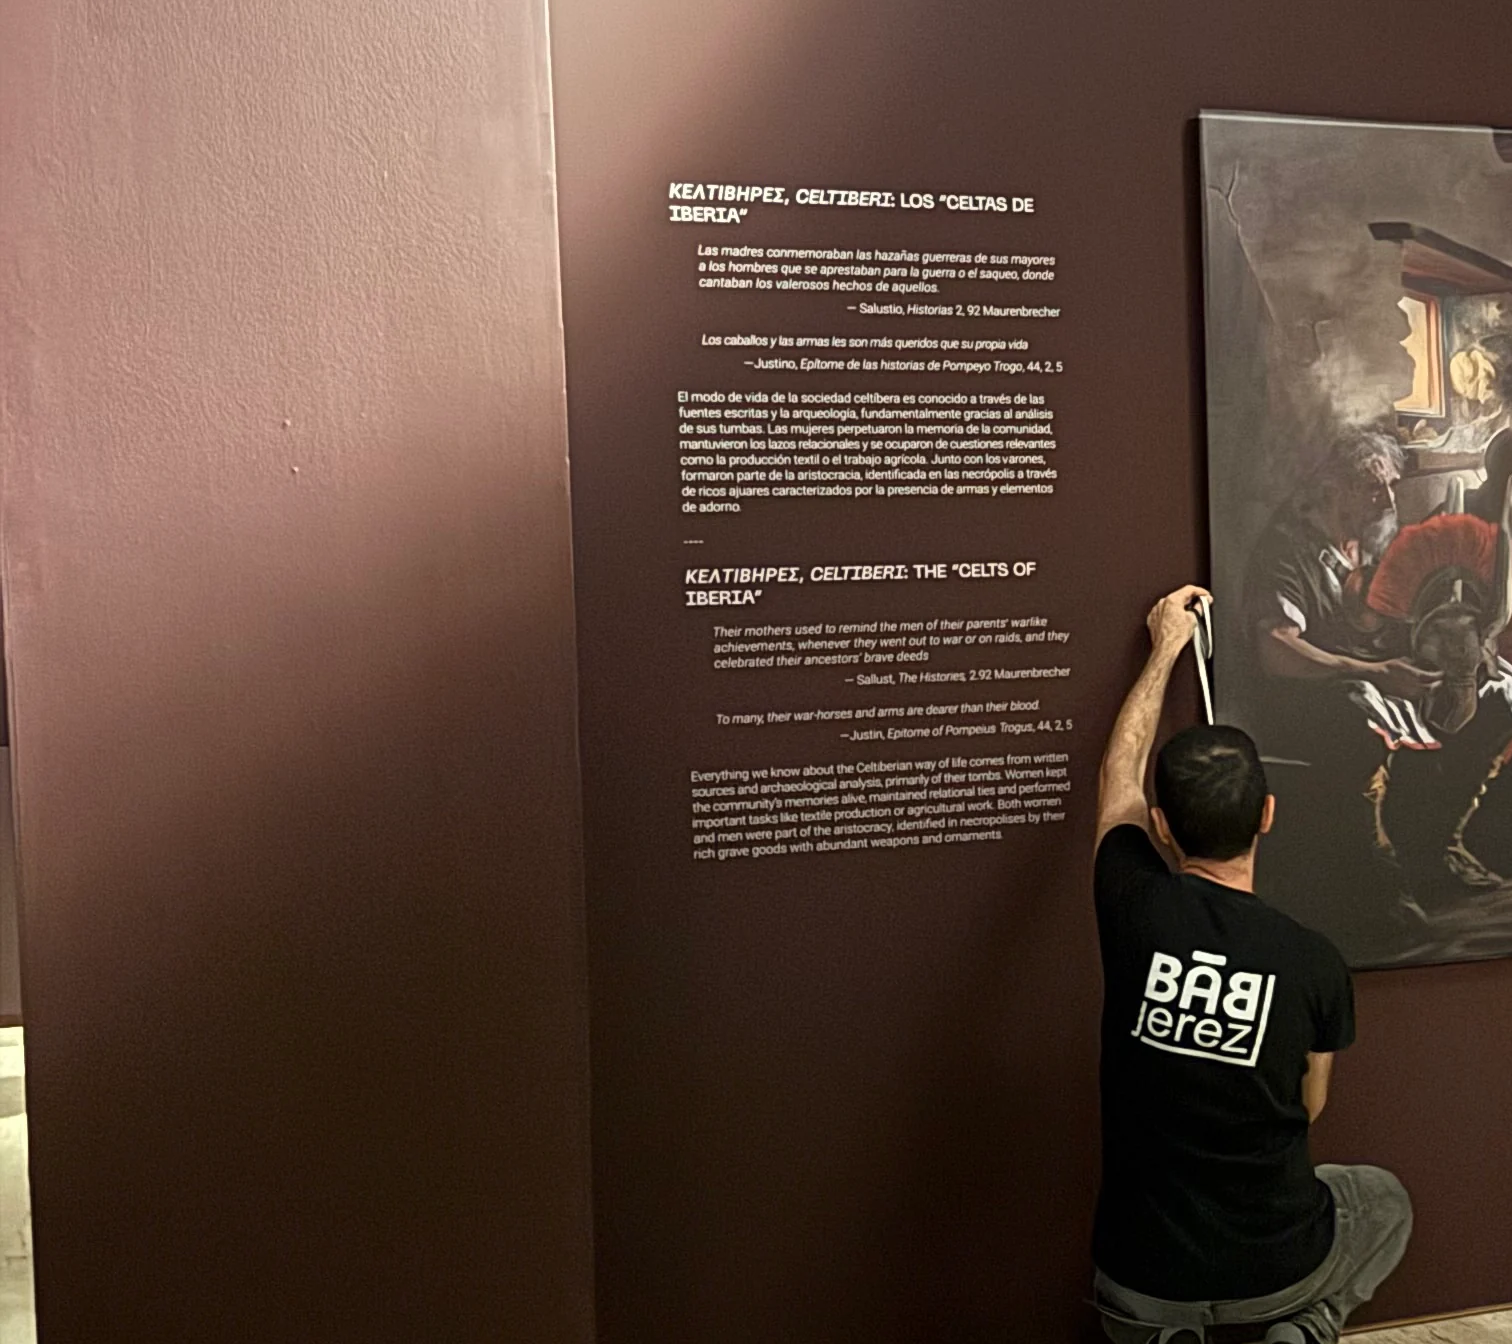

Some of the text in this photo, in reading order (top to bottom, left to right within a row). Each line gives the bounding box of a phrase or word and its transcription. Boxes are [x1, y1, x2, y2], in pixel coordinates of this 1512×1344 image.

[795, 188, 895, 207] CELTIBERI:
[900, 192, 935, 209] LOS
[1011, 197, 1034, 213] DE
[697, 243, 1055, 267] Las madres conmemoraban las hazañas guerreras de sus mayores
[698, 260, 1055, 281] a los hombres que se aprestaban para la guerra o el saqueo, donde
[698, 276, 940, 294] cantaban los valerosos hechos de aquellos.
[680, 467, 1057, 483] formaron parte de la aristocracia, identificada en las necrópolis a través
[810, 564, 908, 581] CELTIBERI:
[912, 563, 947, 579] THE
[1012, 561, 1036, 577] OF
[713, 625, 742, 638] Their
[744, 625, 792, 636] mothers
[794, 623, 823, 635] used
[825, 623, 836, 634] to
[838, 621, 878, 634] remind
[879, 621, 897, 632] the
[899, 621, 924, 631] men
[925, 618, 939, 631] of
[940, 619, 964, 630] their
[1010, 616, 1048, 632] warlike
[713, 630, 1070, 654] achievements, whenever they went out to war or on raids, and they
[713, 655, 774, 669] celebrated
[776, 654, 802, 666] their
[863, 651, 894, 663] brave
[895, 649, 929, 662] deeds
